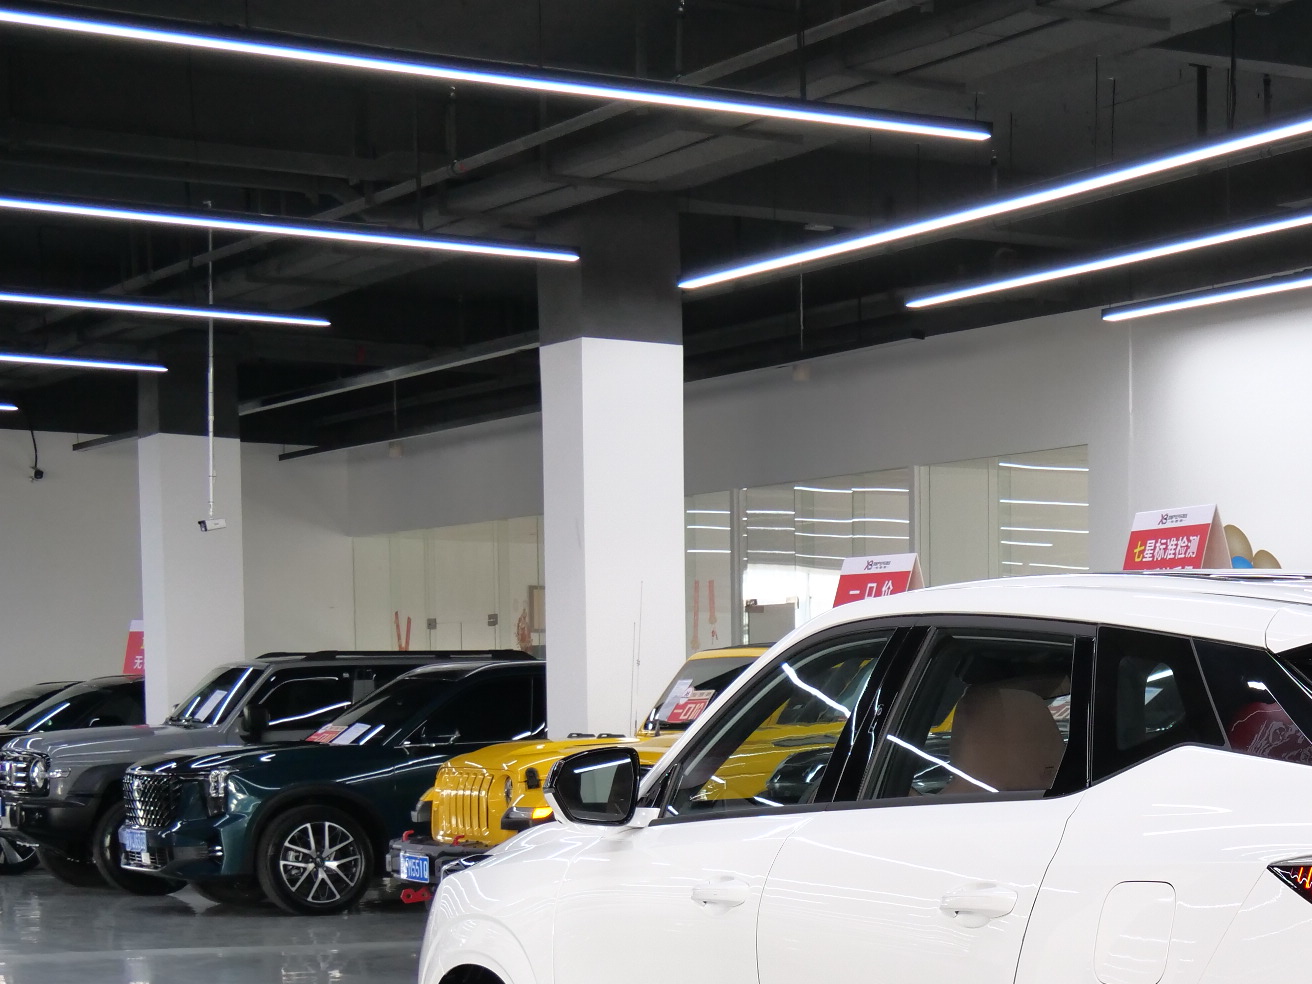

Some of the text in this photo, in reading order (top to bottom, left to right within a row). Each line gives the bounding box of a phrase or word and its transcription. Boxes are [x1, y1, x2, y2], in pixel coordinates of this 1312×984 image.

[1134, 535, 1200, 562] 七星标准检测
[849, 580, 893, 600] 一口价
